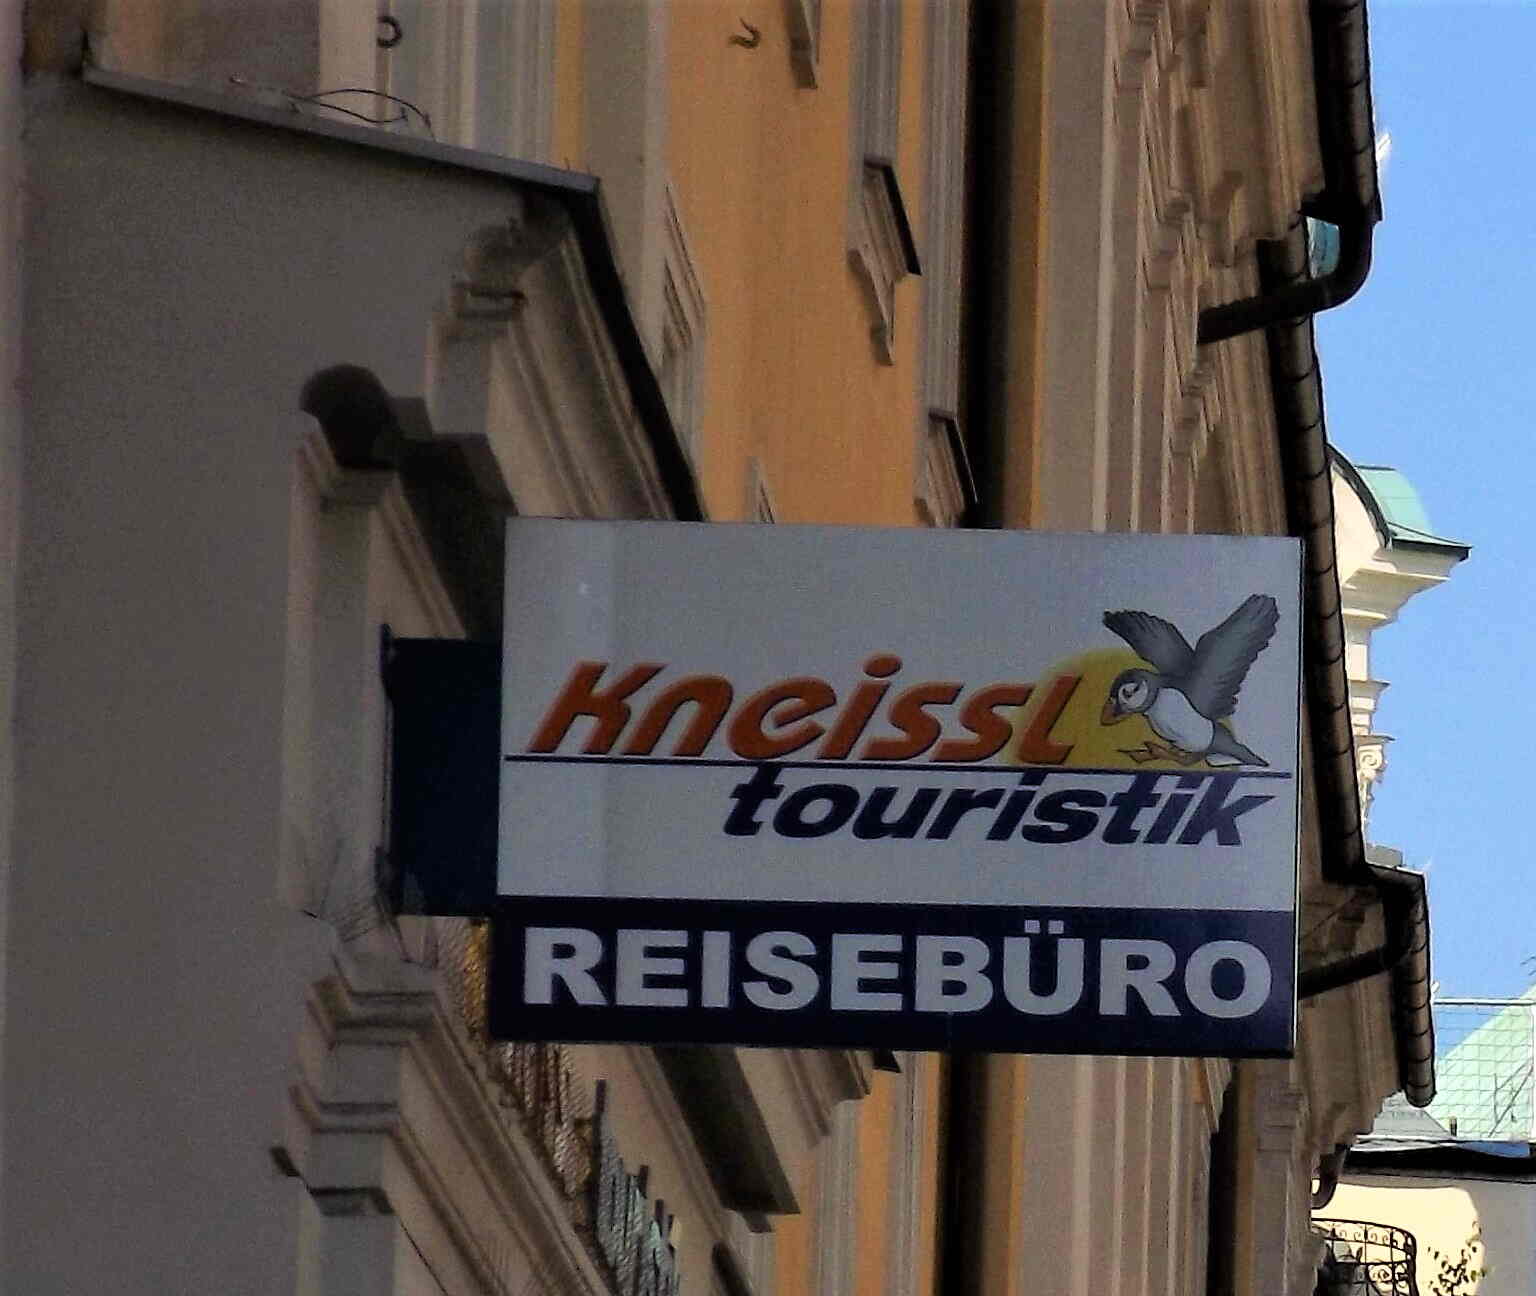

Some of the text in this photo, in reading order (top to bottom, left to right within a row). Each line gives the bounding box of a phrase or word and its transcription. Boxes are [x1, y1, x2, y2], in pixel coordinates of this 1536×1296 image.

[527, 652, 1083, 764] Kneissl
[723, 763, 1276, 847] touristik
[523, 920, 1273, 1020] REISEBÜRO
